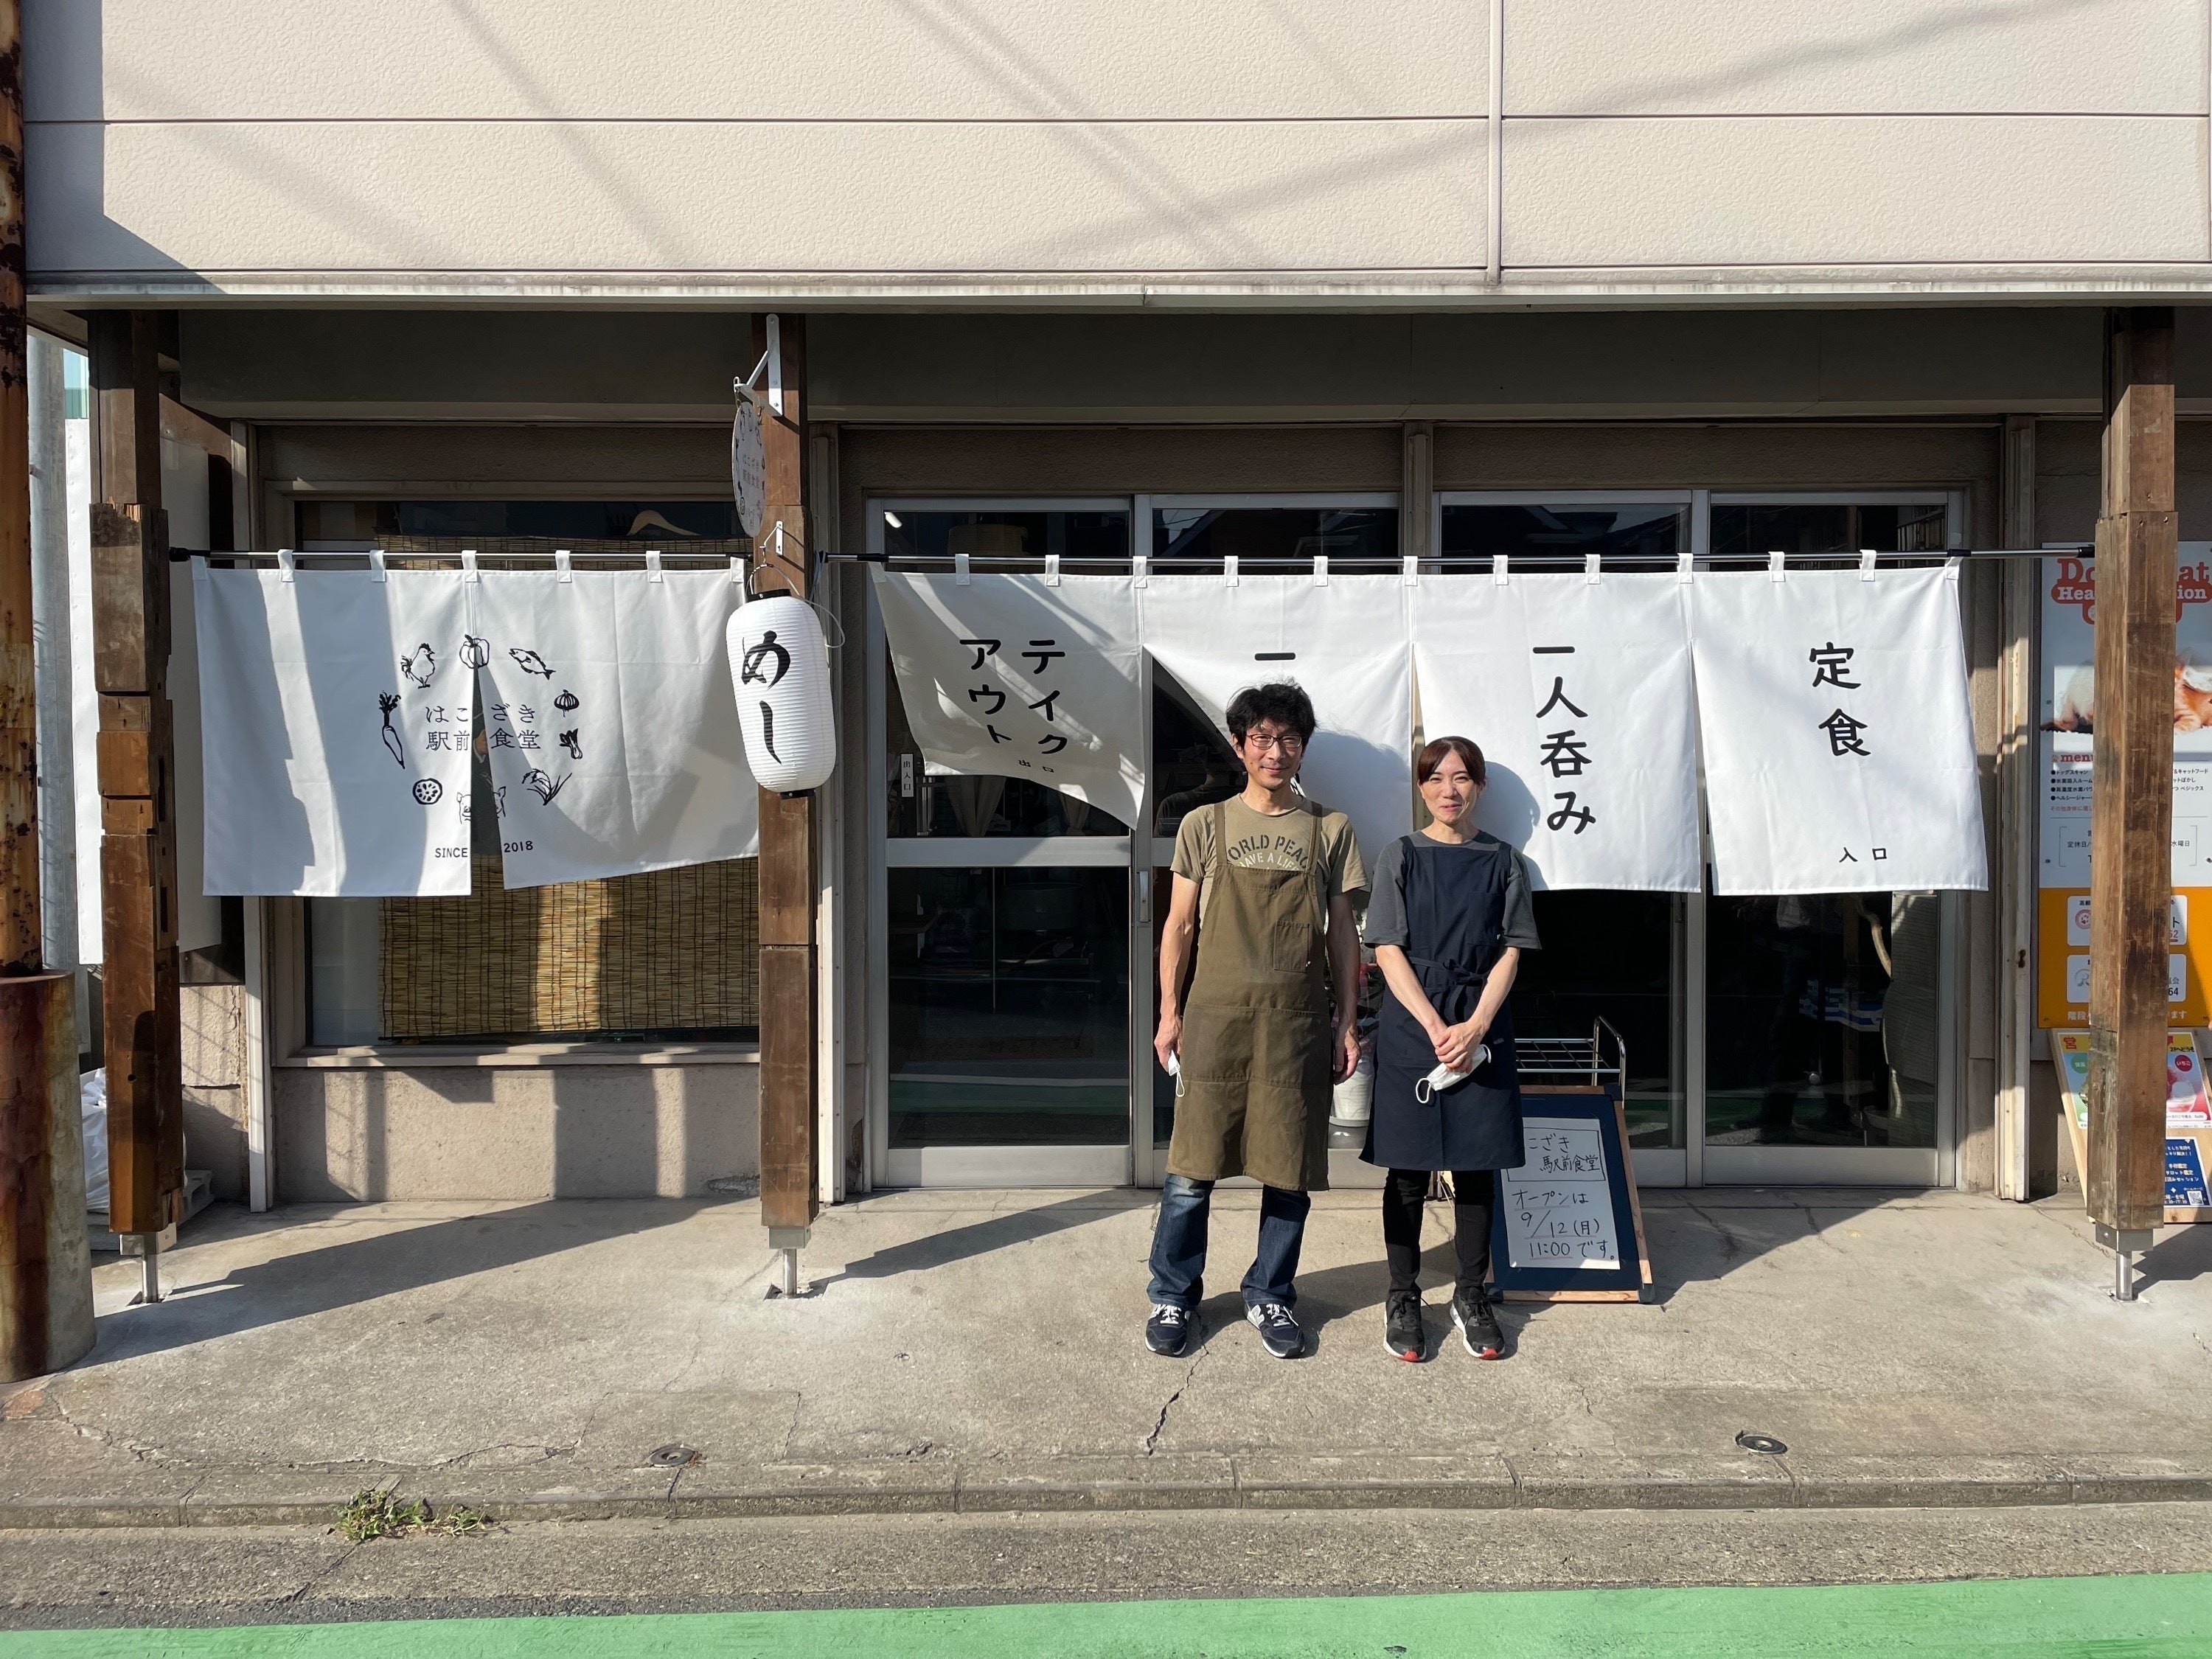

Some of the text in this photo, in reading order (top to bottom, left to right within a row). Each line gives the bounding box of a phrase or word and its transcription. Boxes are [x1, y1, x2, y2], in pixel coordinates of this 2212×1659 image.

[741, 629, 791, 765] めし
[959, 639, 1012, 744] アウト
[1021, 639, 1068, 754] テイク
[1809, 641, 1872, 757] 定食
[425, 703, 536, 724] はこざき
[425, 727, 541, 752] 駅前食堂
[1532, 645, 1596, 835] 一人呑み
[1018, 759, 1055, 773] 出口
[2060, 754, 2093, 762] men
[902, 760, 911, 790] 出入口
[434, 840, 534, 858] SINCE 2018
[1227, 834, 1309, 869] ORLD PEAC
[1838, 846, 1888, 863] 入口
[1540, 1155, 1601, 1174] 駅前食堂
[1512, 1189, 1589, 1209] オープンは
